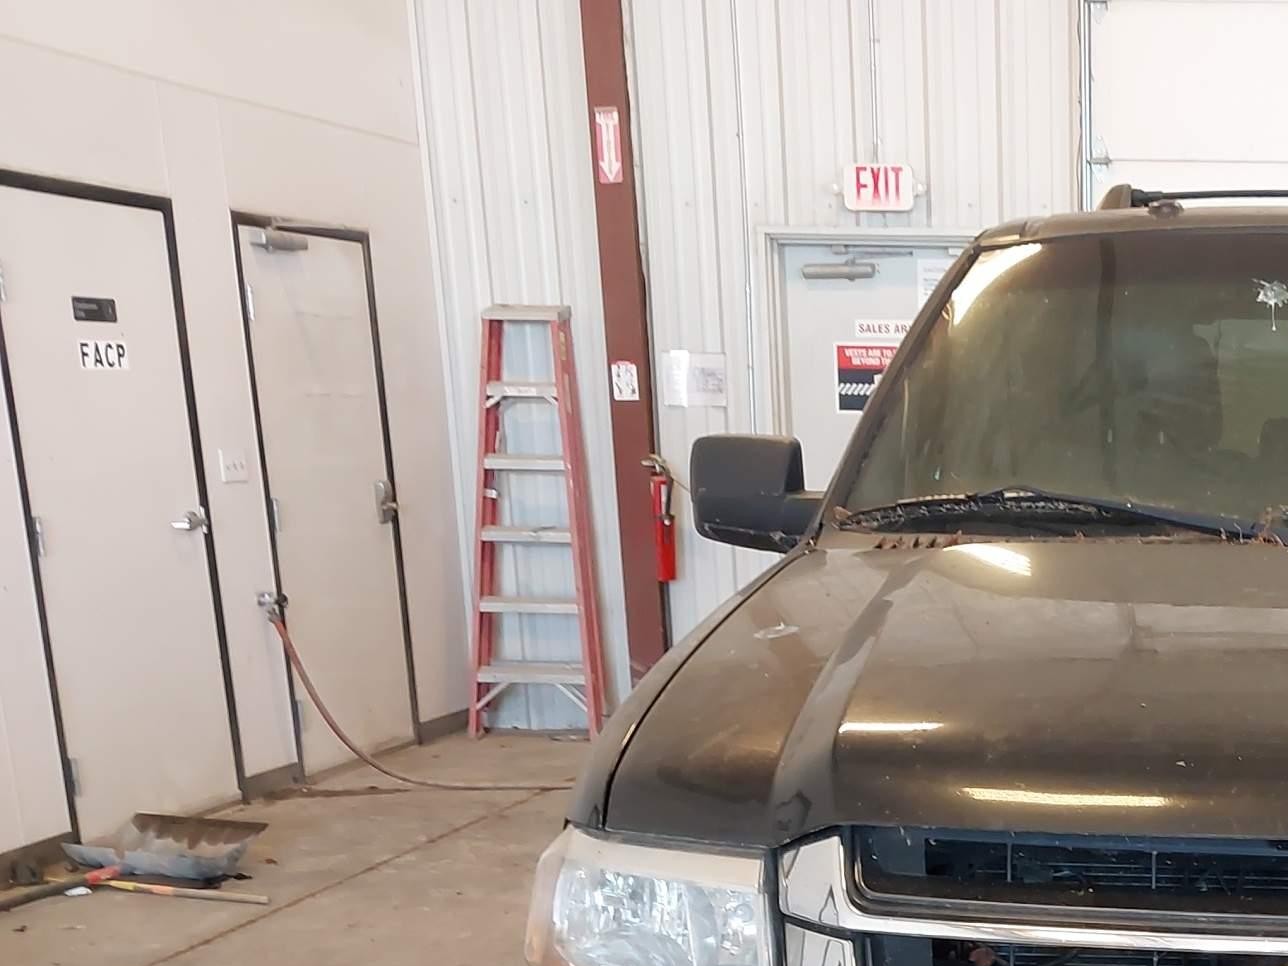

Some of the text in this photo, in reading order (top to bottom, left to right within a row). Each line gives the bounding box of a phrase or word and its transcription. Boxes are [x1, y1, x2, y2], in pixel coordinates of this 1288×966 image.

[855, 166, 903, 201] EXIT
[858, 323, 911, 335] SALES AR
[80, 342, 125, 367] FACP
